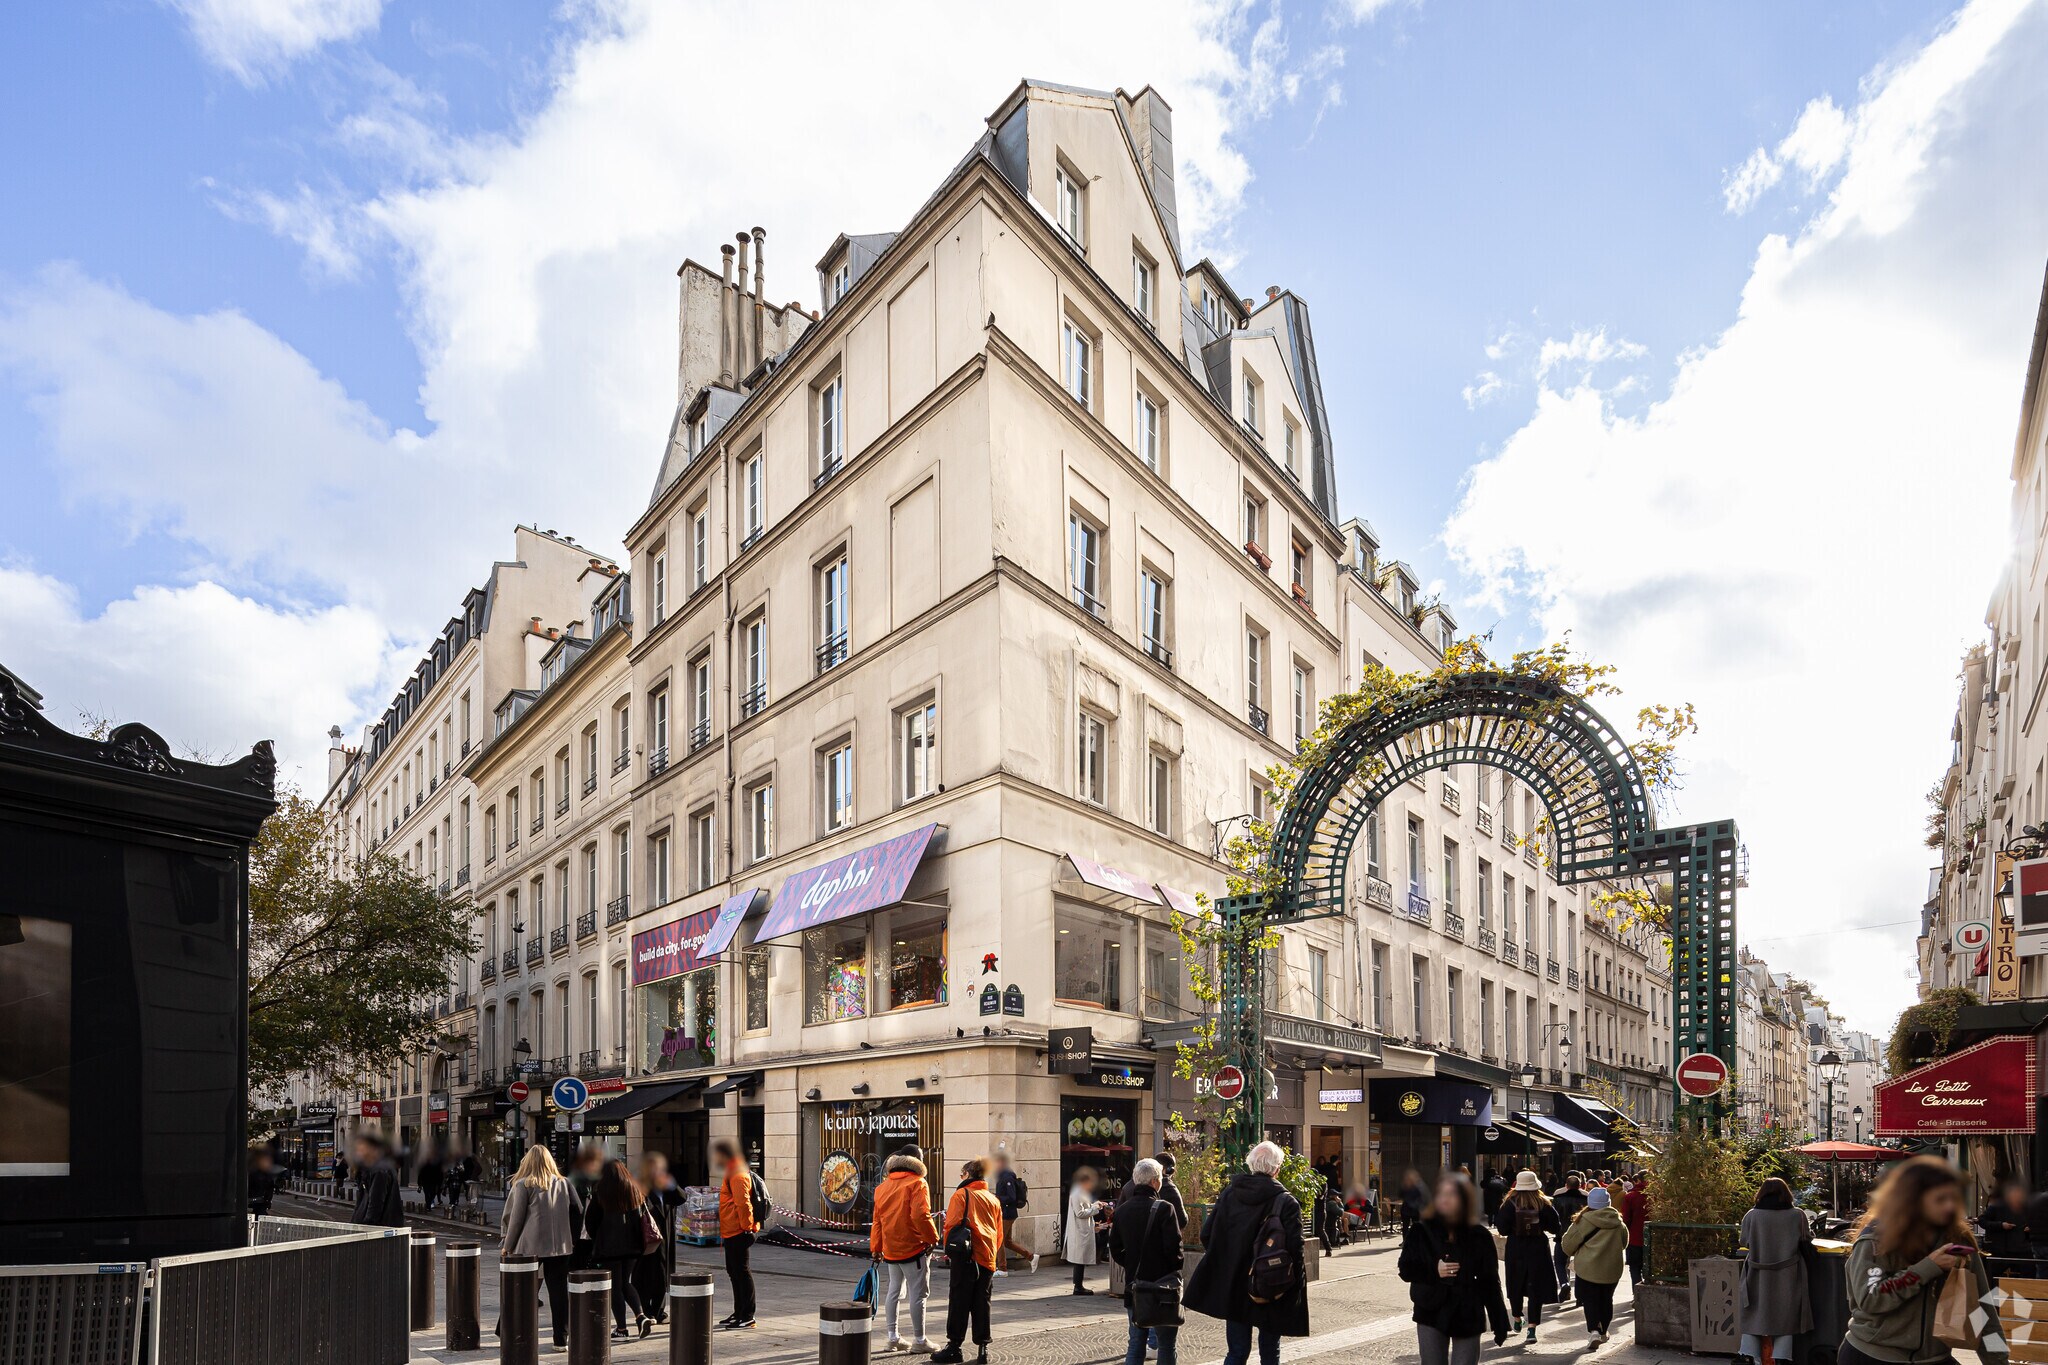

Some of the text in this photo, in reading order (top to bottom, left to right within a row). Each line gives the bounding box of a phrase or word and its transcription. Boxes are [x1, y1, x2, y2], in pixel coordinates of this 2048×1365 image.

[1302, 715, 1606, 880] MARCH MONTORGUEIL
[801, 857, 875, 920] daphni
[639, 929, 712, 963] build da city. for.goo
[1964, 929, 1983, 944] U
[1271, 1018, 1326, 1045] BOULANGER
[1905, 1079, 1972, 1093] Les Petits
[1336, 1094, 1362, 1102] KAYSER
[1921, 1094, 1988, 1107] Carreaux
[824, 1112, 834, 1131] le
[835, 1115, 865, 1135] curry
[1917, 1119, 1938, 1127] Café
[1945, 1118, 1987, 1127] Brasserie
